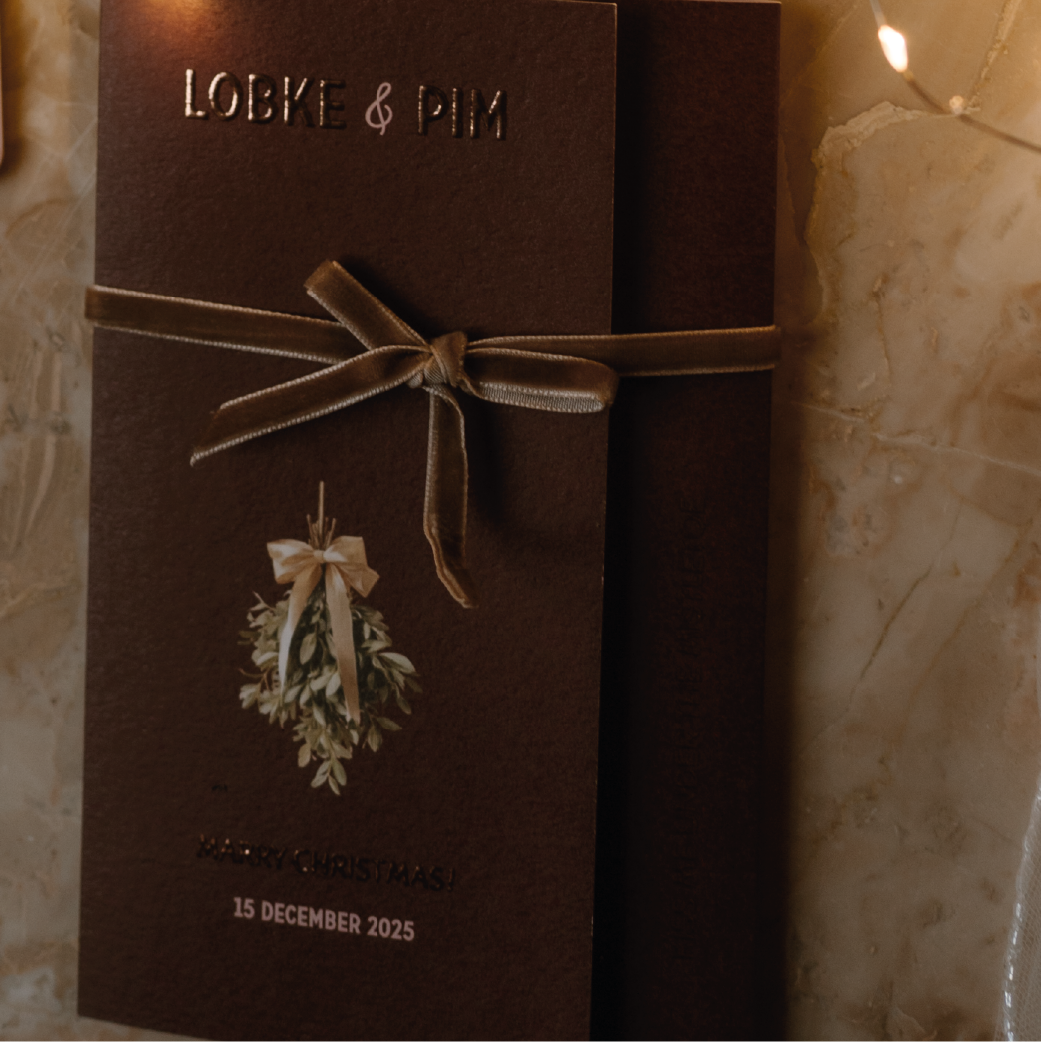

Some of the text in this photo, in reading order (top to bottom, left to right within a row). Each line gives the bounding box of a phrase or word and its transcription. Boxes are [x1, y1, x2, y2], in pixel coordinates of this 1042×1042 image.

[184, 68, 508, 140] LOBKE & PIM
[293, 848, 457, 892] CHRISTMAS!
[233, 896, 416, 943] 15 DECEMBER 2025
